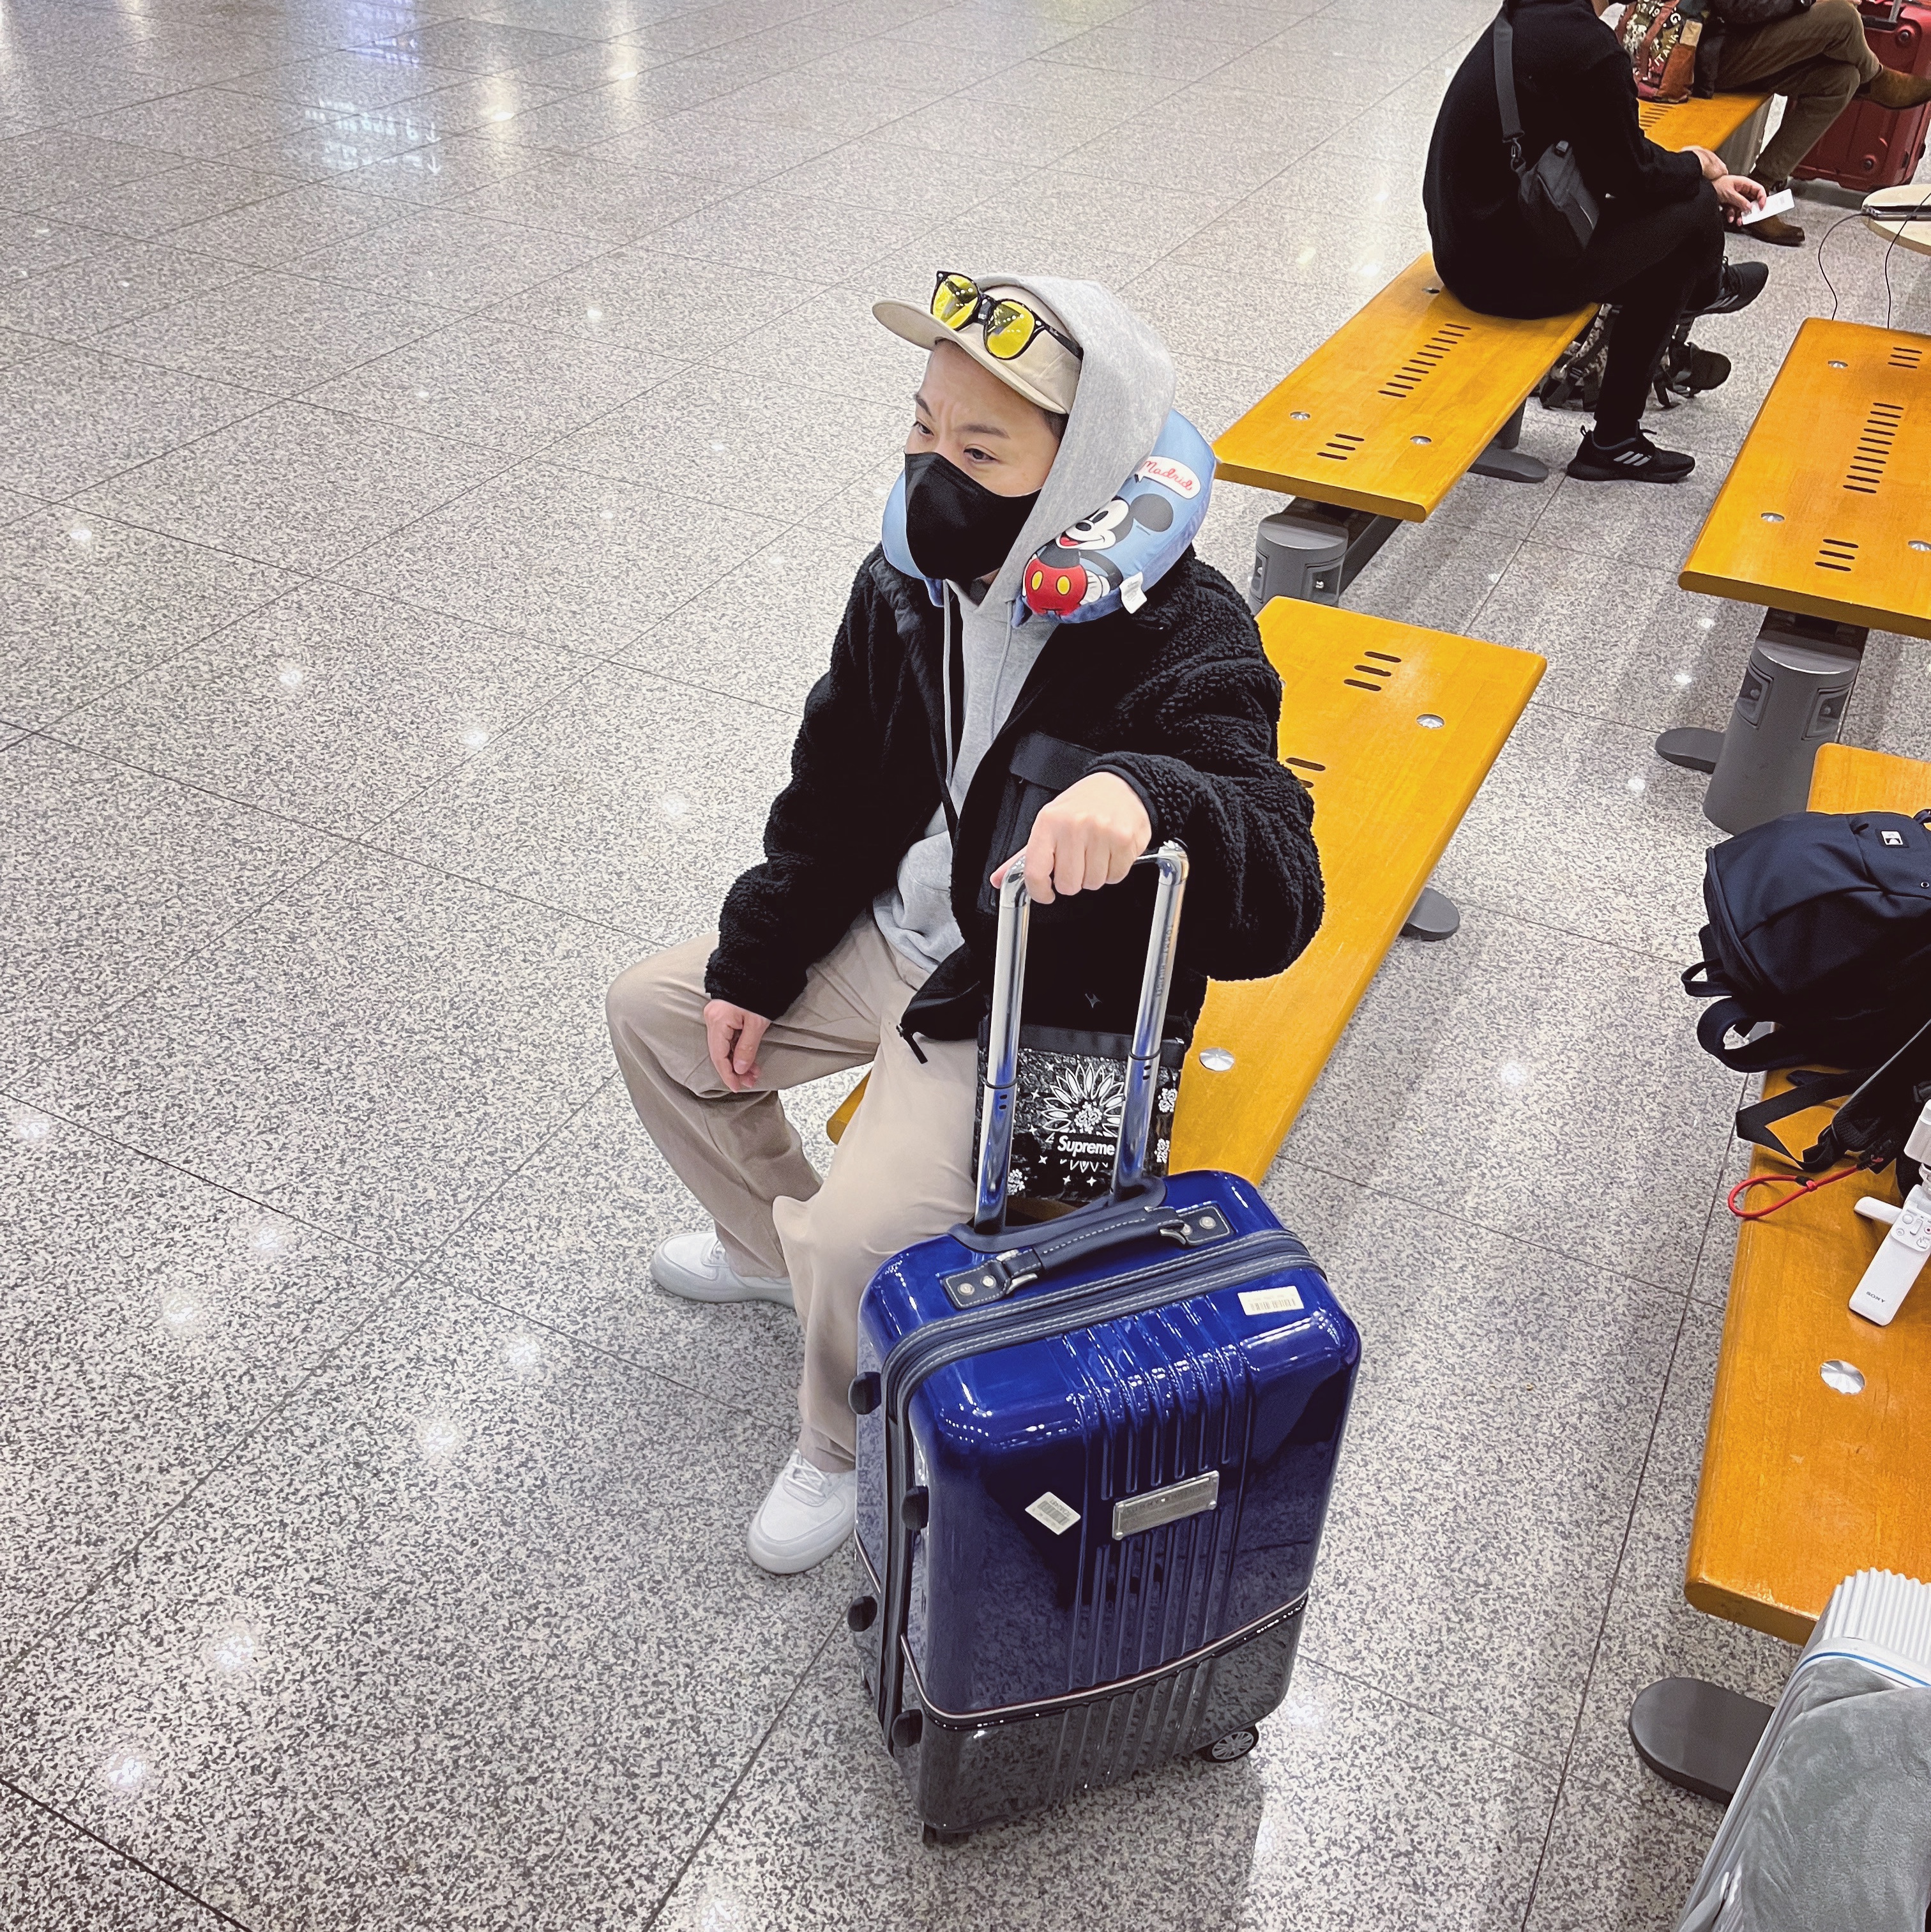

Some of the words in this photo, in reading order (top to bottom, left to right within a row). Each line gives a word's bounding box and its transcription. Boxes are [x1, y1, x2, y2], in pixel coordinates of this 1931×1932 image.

[1139, 460, 1193, 491] Madrid
[1057, 1135, 1115, 1157] Supreme
[1866, 1291, 1885, 1303] SONY
